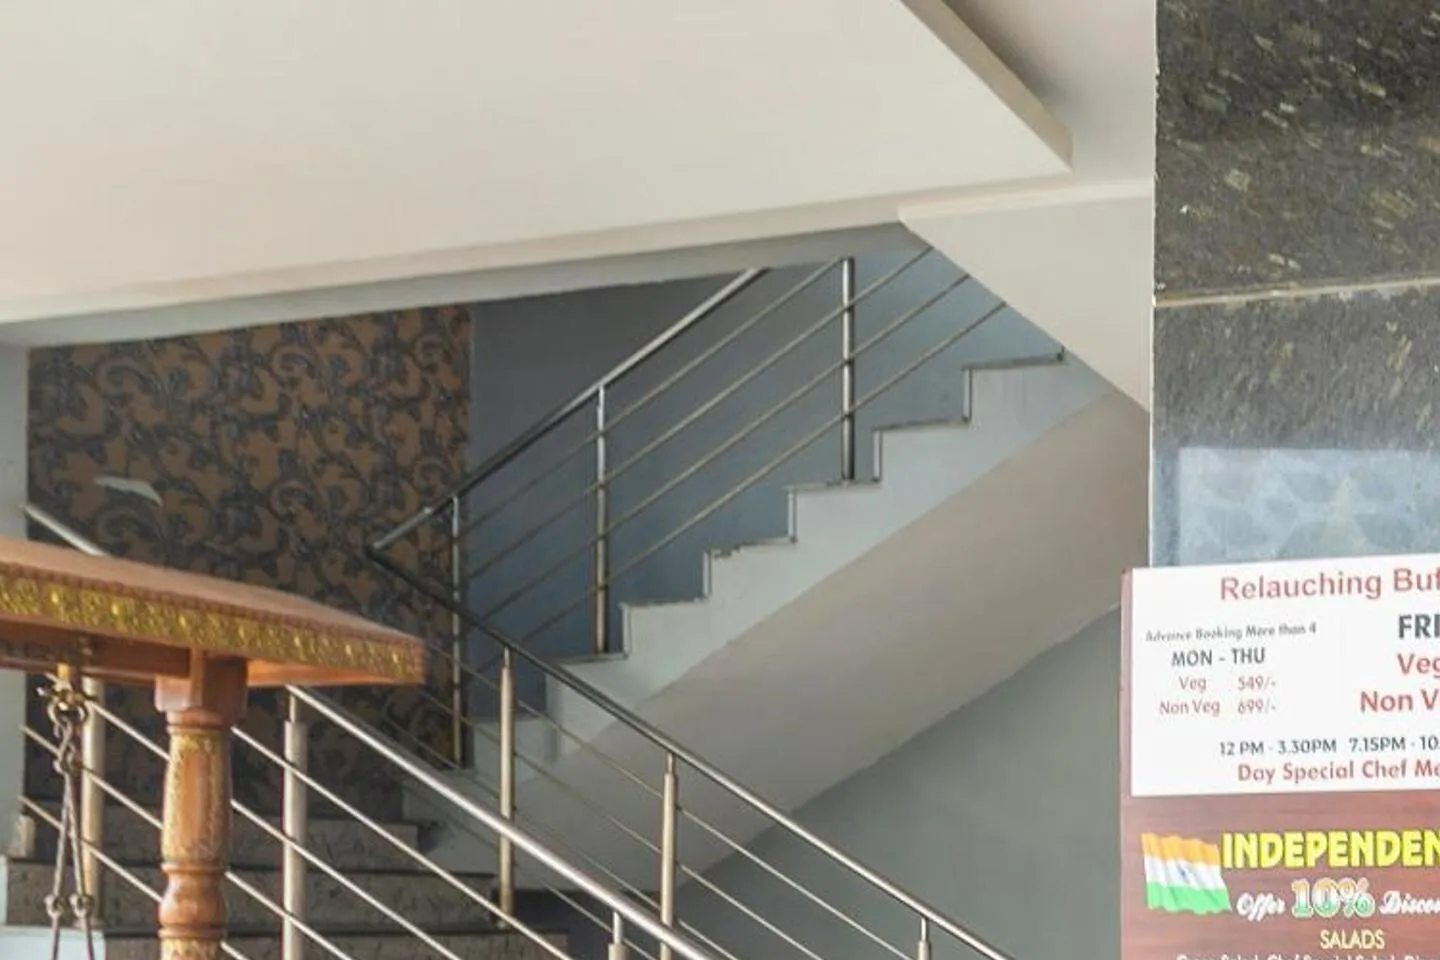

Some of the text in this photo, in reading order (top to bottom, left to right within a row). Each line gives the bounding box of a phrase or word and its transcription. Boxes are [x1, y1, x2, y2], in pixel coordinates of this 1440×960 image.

[1220, 571, 1381, 601] Relauching
[1196, 624, 1242, 642] Booking
[1246, 624, 1275, 637] More
[1278, 623, 1306, 635] than
[1398, 613, 1440, 639] FRI
[1171, 647, 1266, 667] MON THU
[1178, 676, 1207, 692] Veg
[1159, 700, 1189, 715] Non
[1192, 699, 1221, 716] Veg
[1360, 691, 1413, 713] Non
[1219, 741, 1235, 756] 12
[1239, 740, 1265, 755] PM
[1238, 763, 1276, 785] Day
[1283, 760, 1354, 784] Special
[1362, 759, 1407, 778] Chef
[1237, 893, 1285, 921] Offer
[1291, 877, 1376, 919] 10%
[1320, 929, 1385, 950] SALADS
